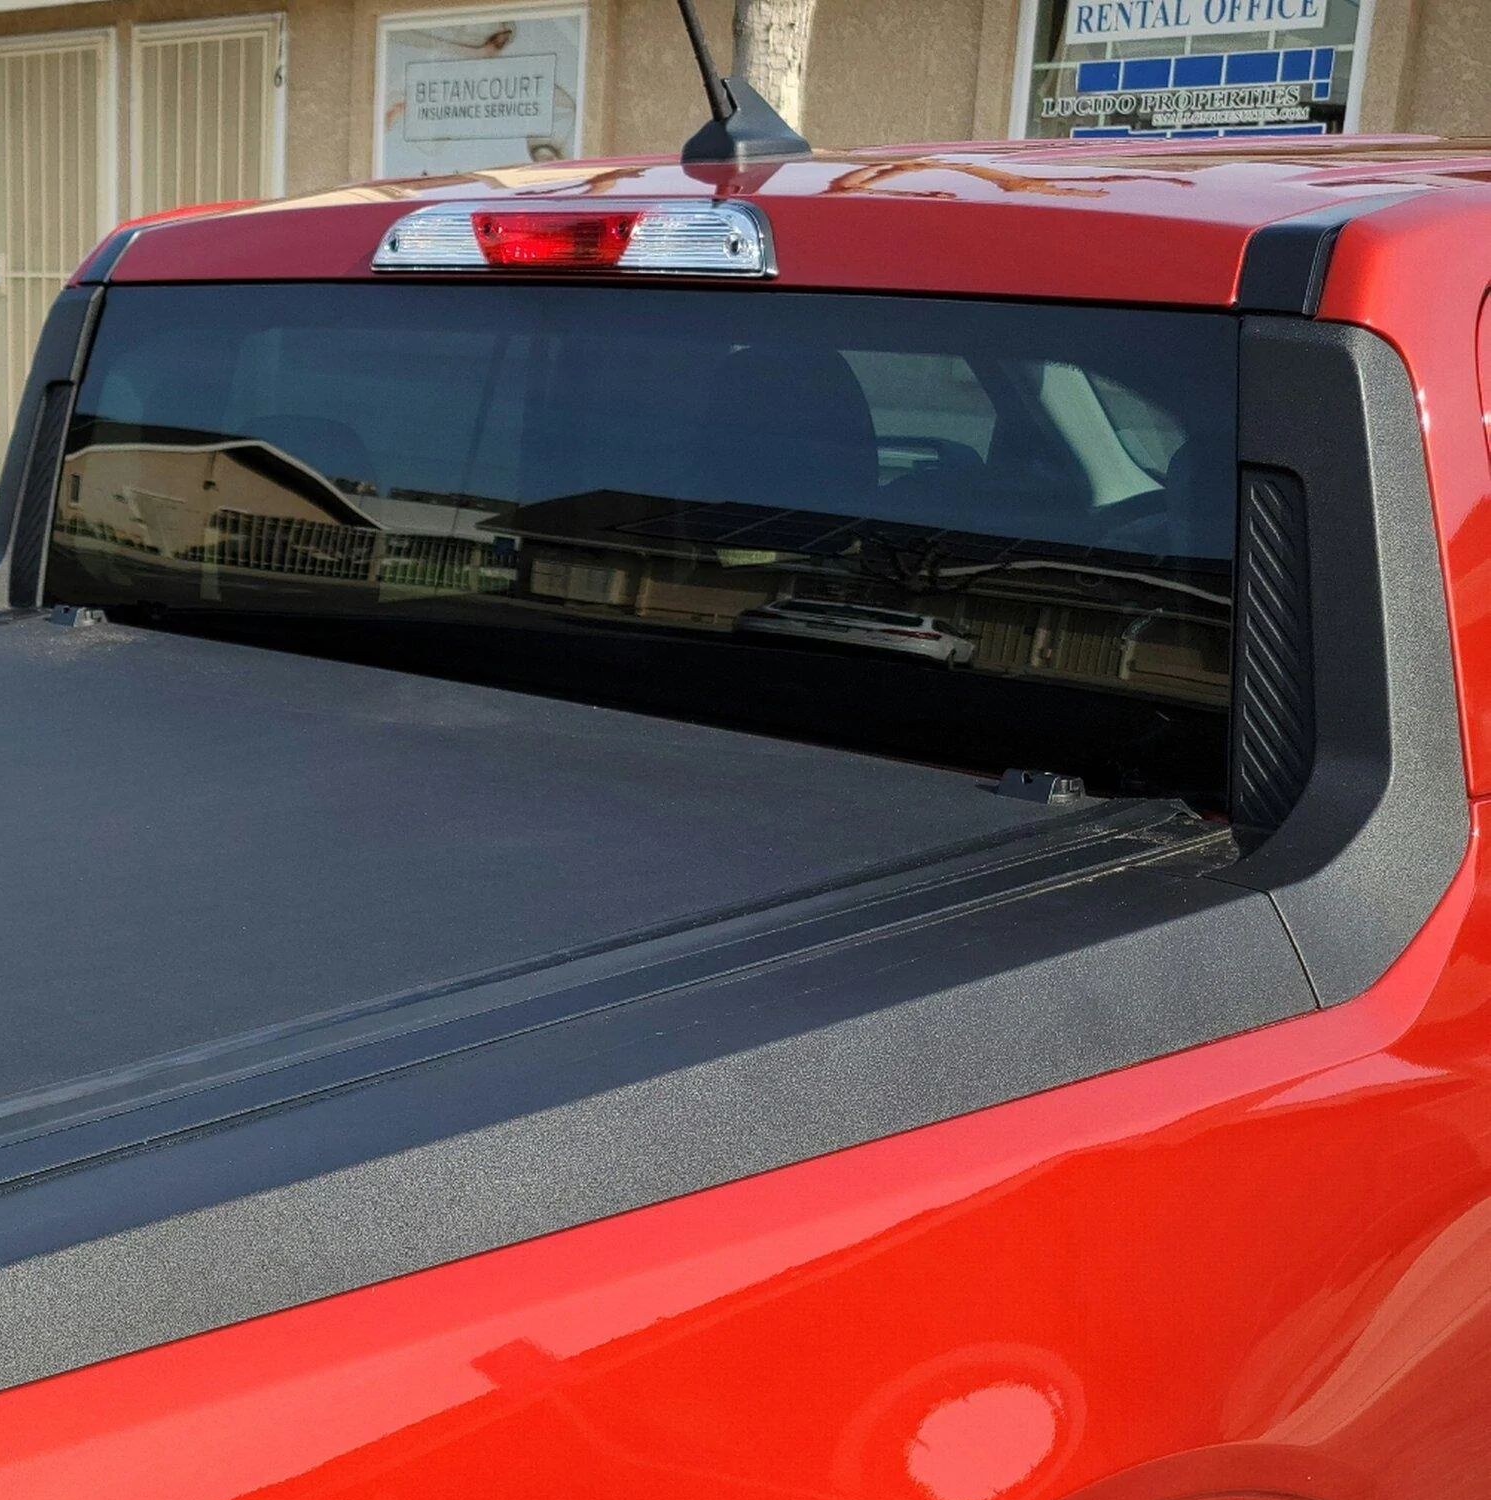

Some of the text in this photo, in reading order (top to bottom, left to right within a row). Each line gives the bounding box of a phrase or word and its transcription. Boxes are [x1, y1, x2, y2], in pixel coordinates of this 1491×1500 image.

[1076, 0, 1319, 34] RENTAL OFFICE
[415, 75, 544, 103] BETANCOURT
[1041, 85, 1301, 118] LUCIDO PROPERTIES
[418, 102, 539, 121] INSURANCE SERVICES
